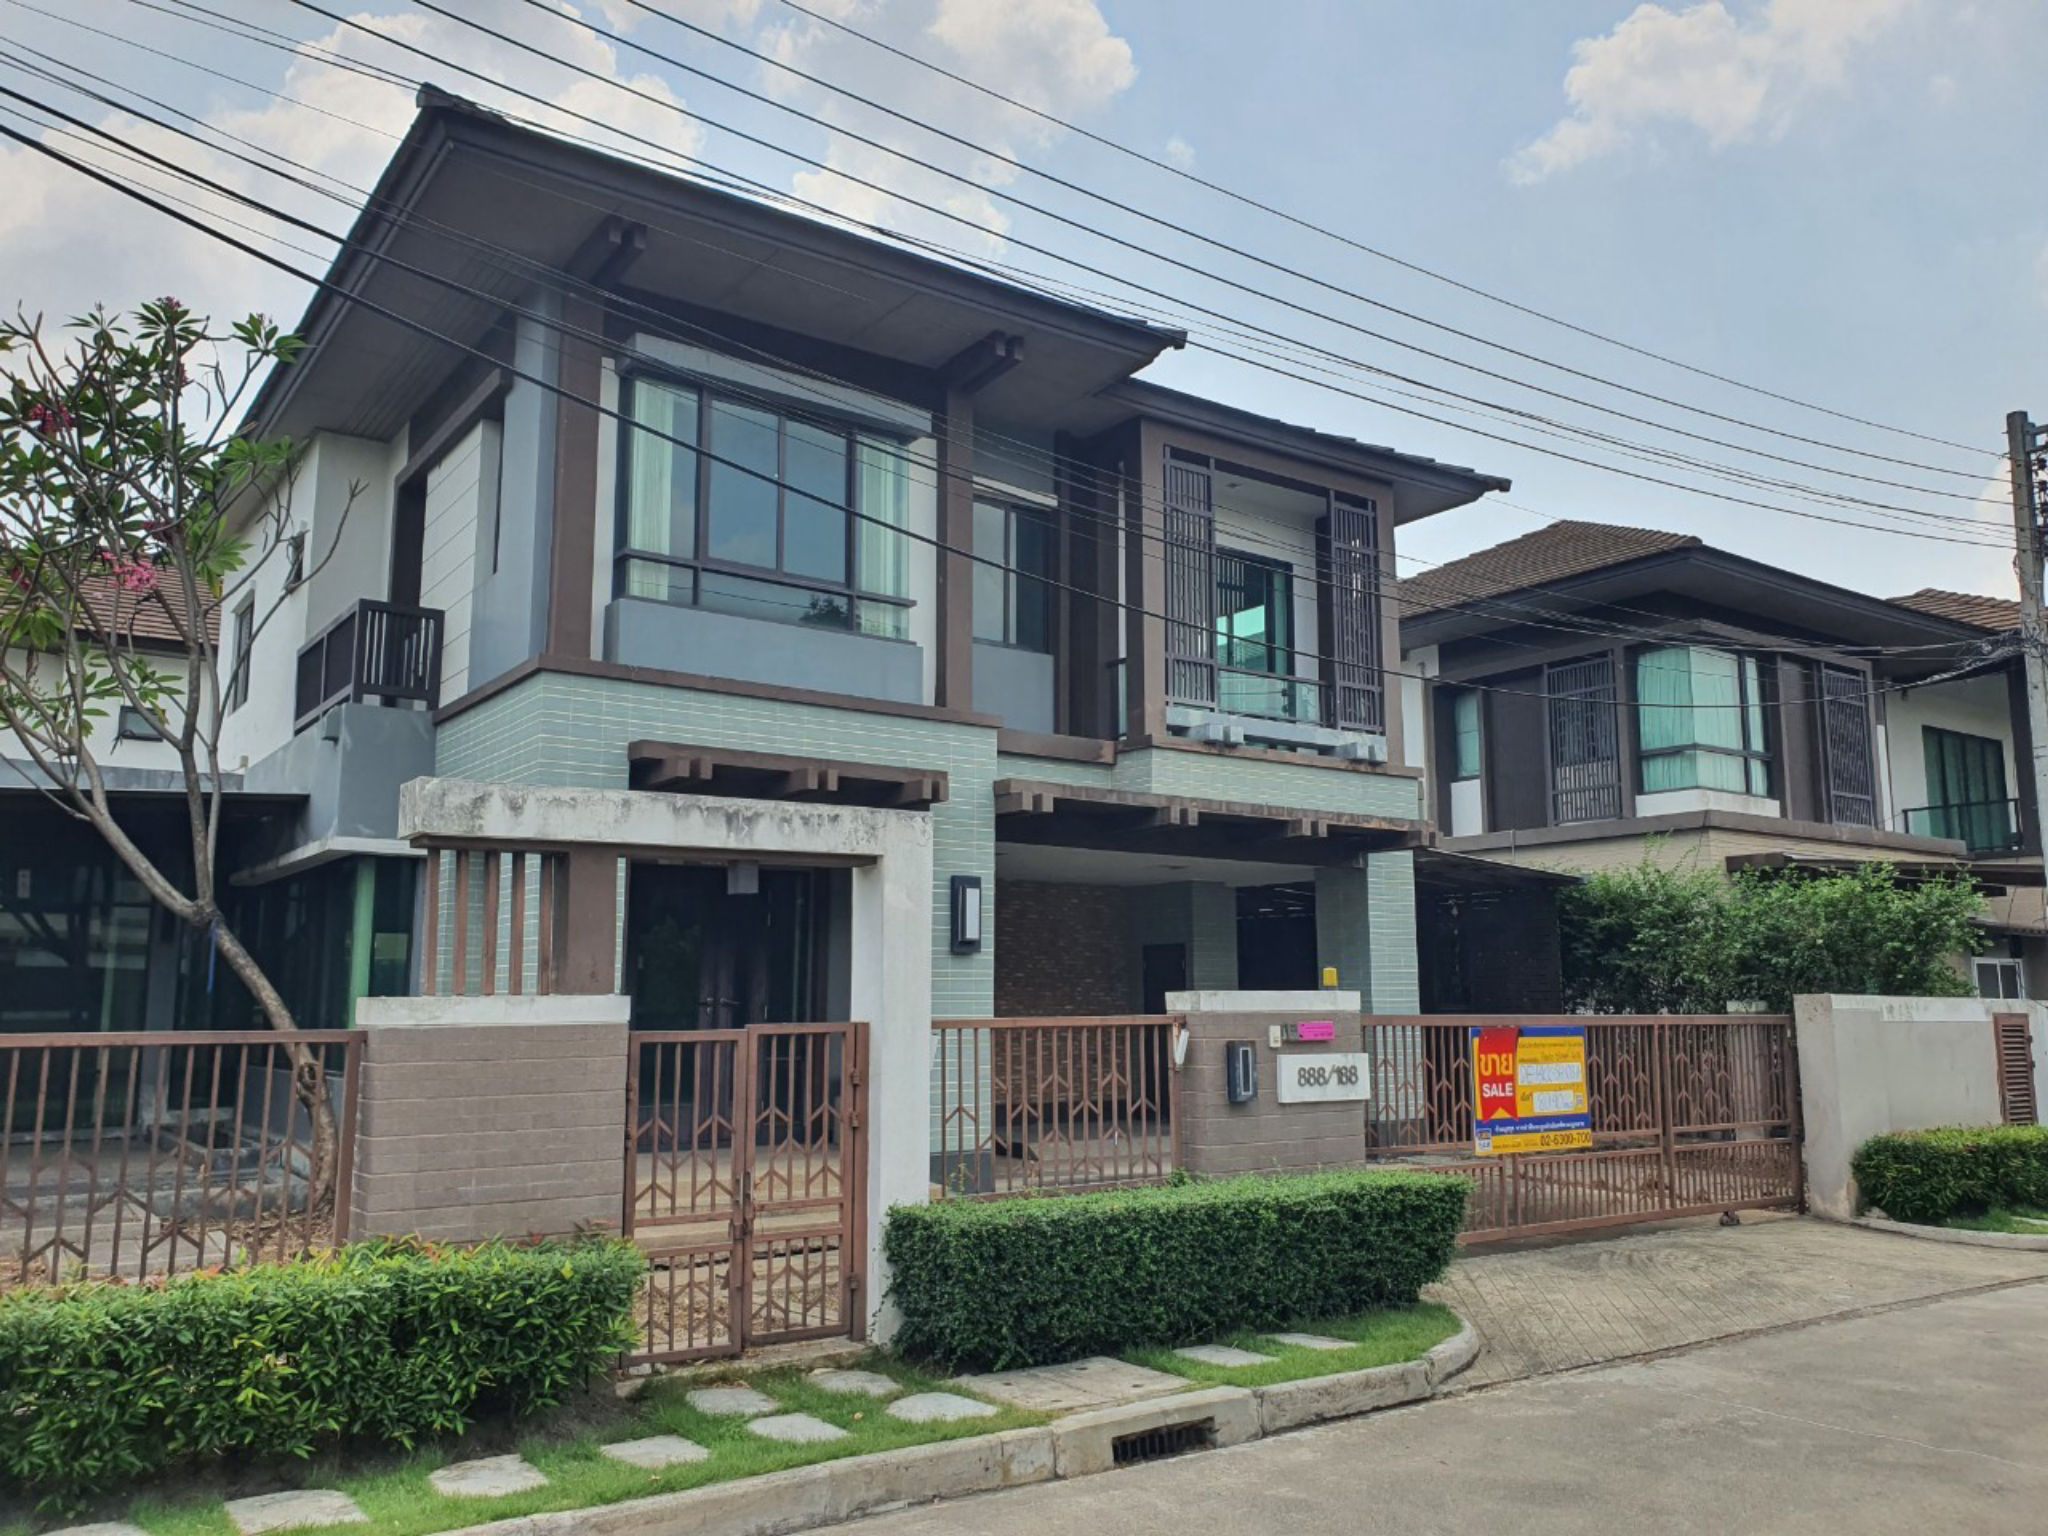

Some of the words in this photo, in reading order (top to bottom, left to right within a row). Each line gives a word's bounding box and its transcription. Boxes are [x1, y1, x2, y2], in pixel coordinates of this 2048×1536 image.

[1480, 1053, 1513, 1075] ขาย
[1298, 1064, 1358, 1087] 888/188
[1482, 1083, 1513, 1098] SALE
